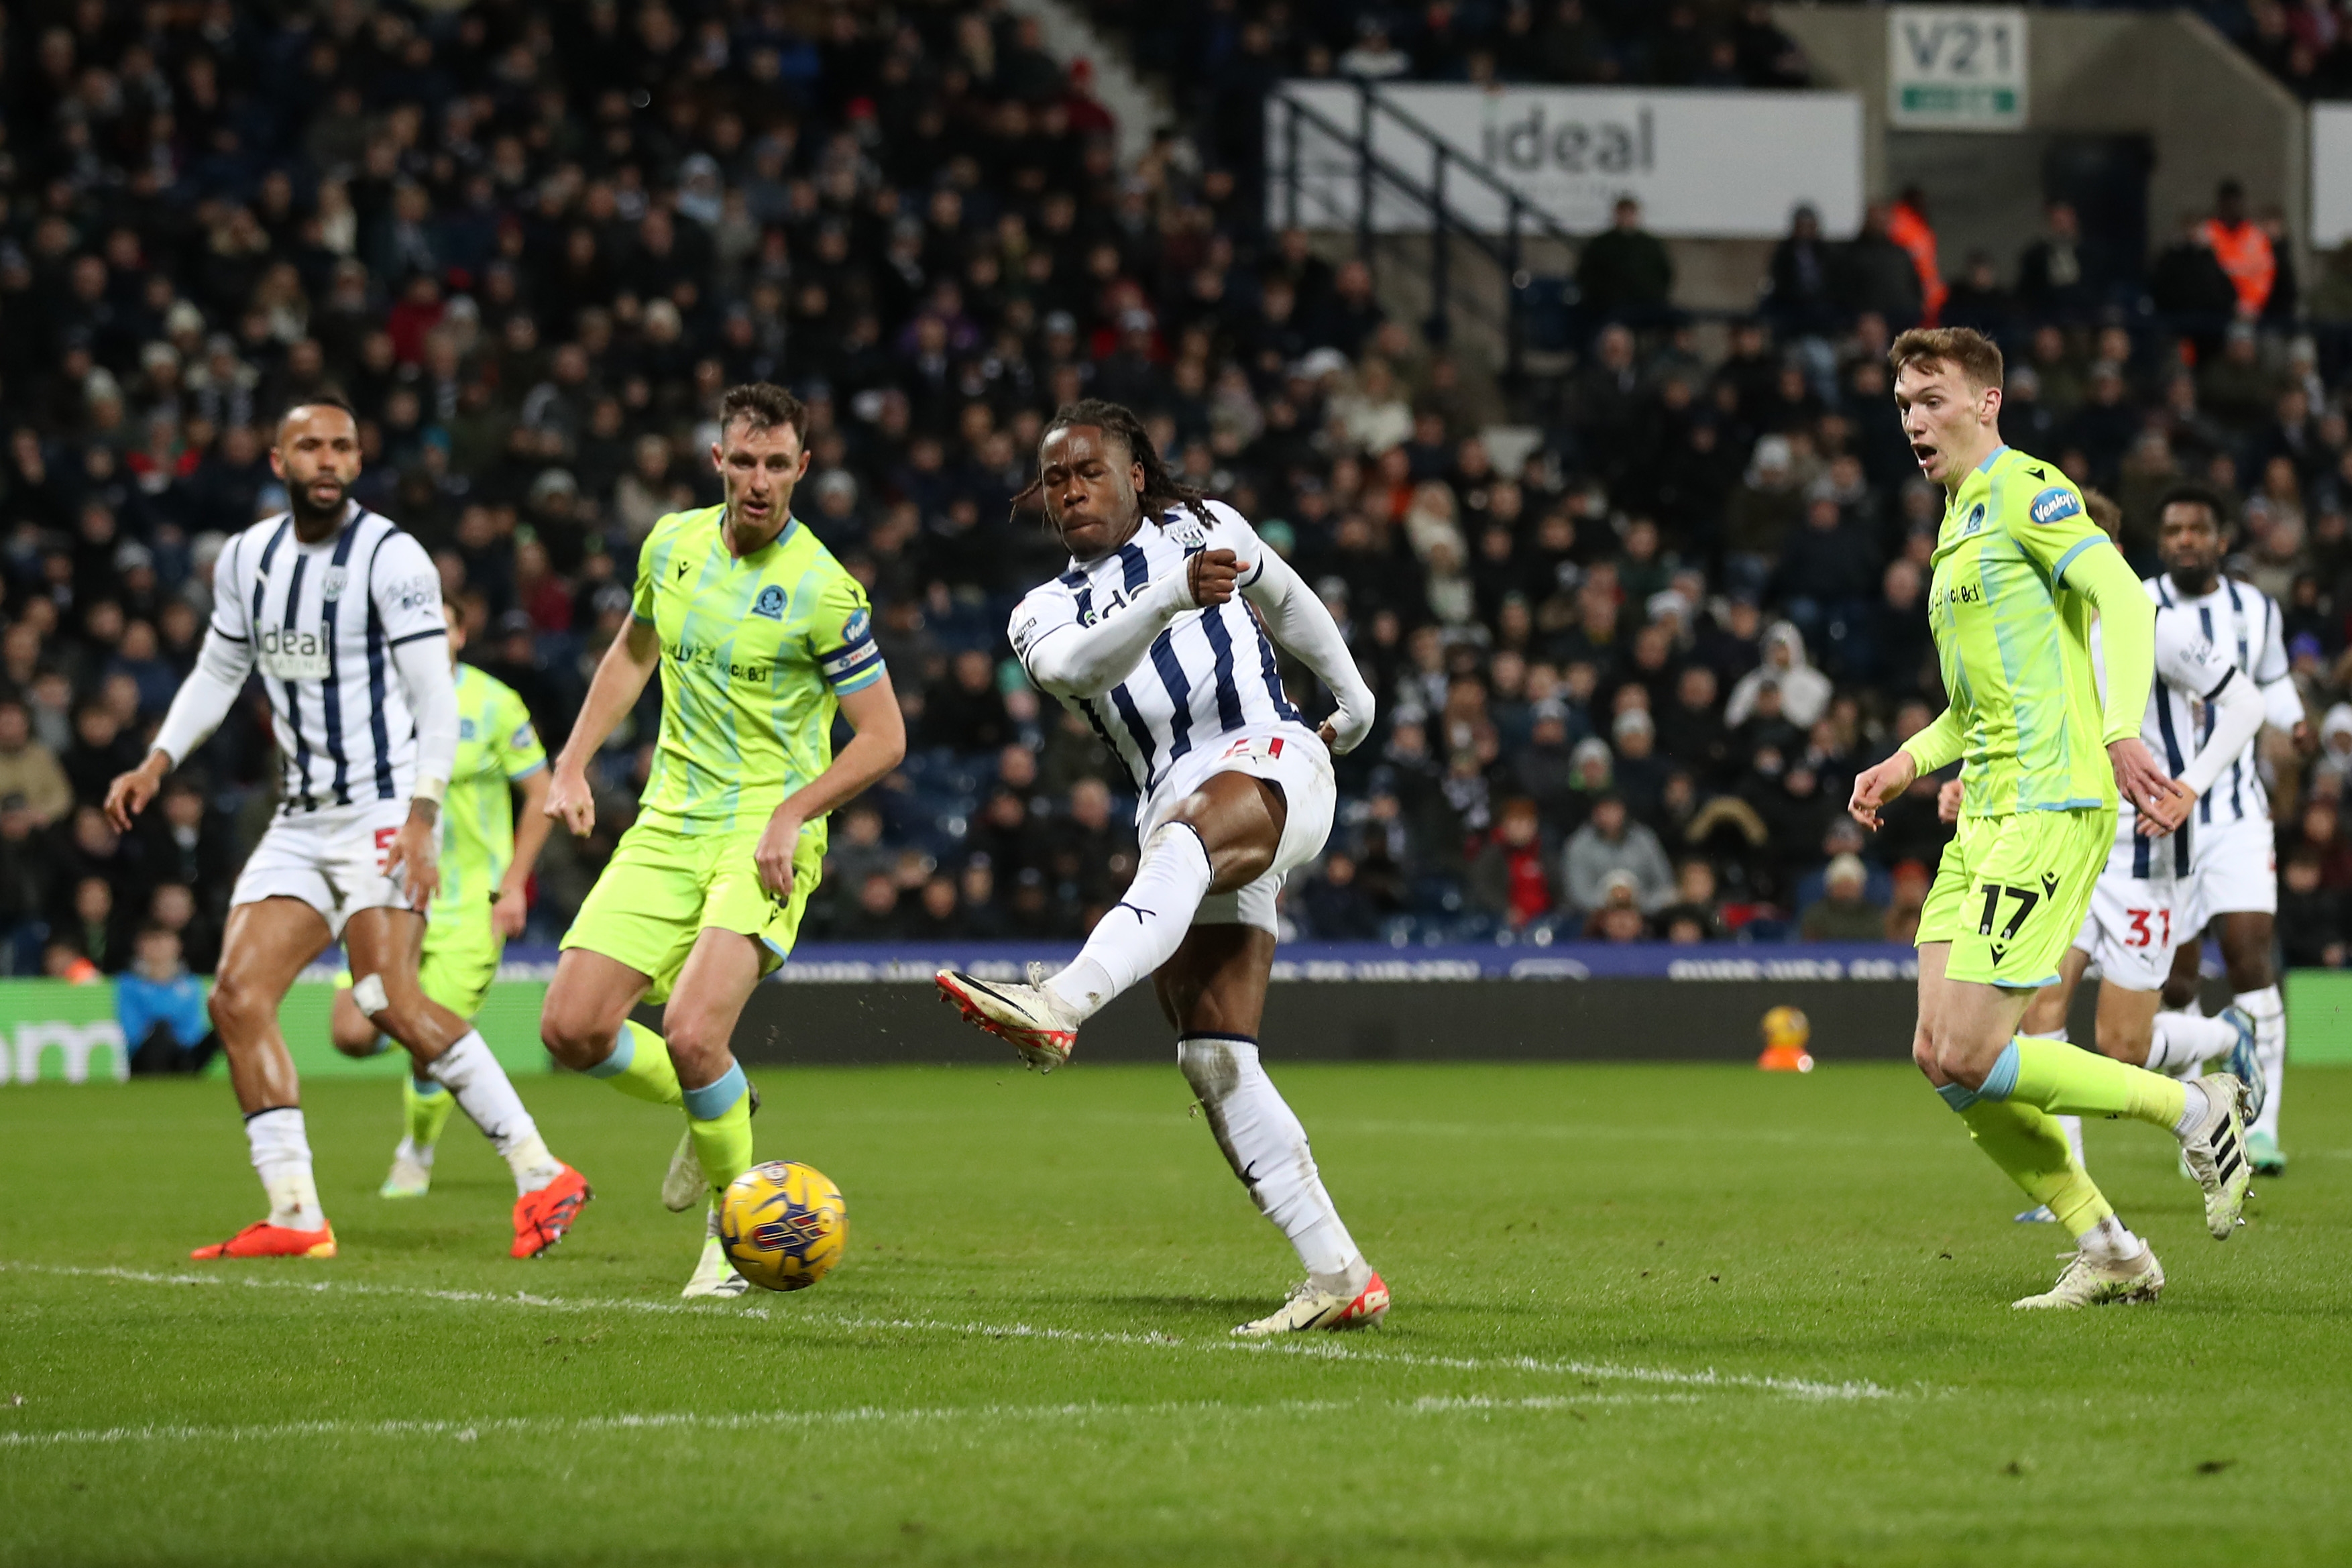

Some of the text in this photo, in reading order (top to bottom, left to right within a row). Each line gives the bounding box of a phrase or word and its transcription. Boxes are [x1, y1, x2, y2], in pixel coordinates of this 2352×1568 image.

[1903, 21, 2011, 73] V21
[1481, 102, 1654, 172] ideal
[1978, 884, 2039, 940] 17
[2124, 908, 2170, 948] 31
[0, 1020, 131, 1084] m
